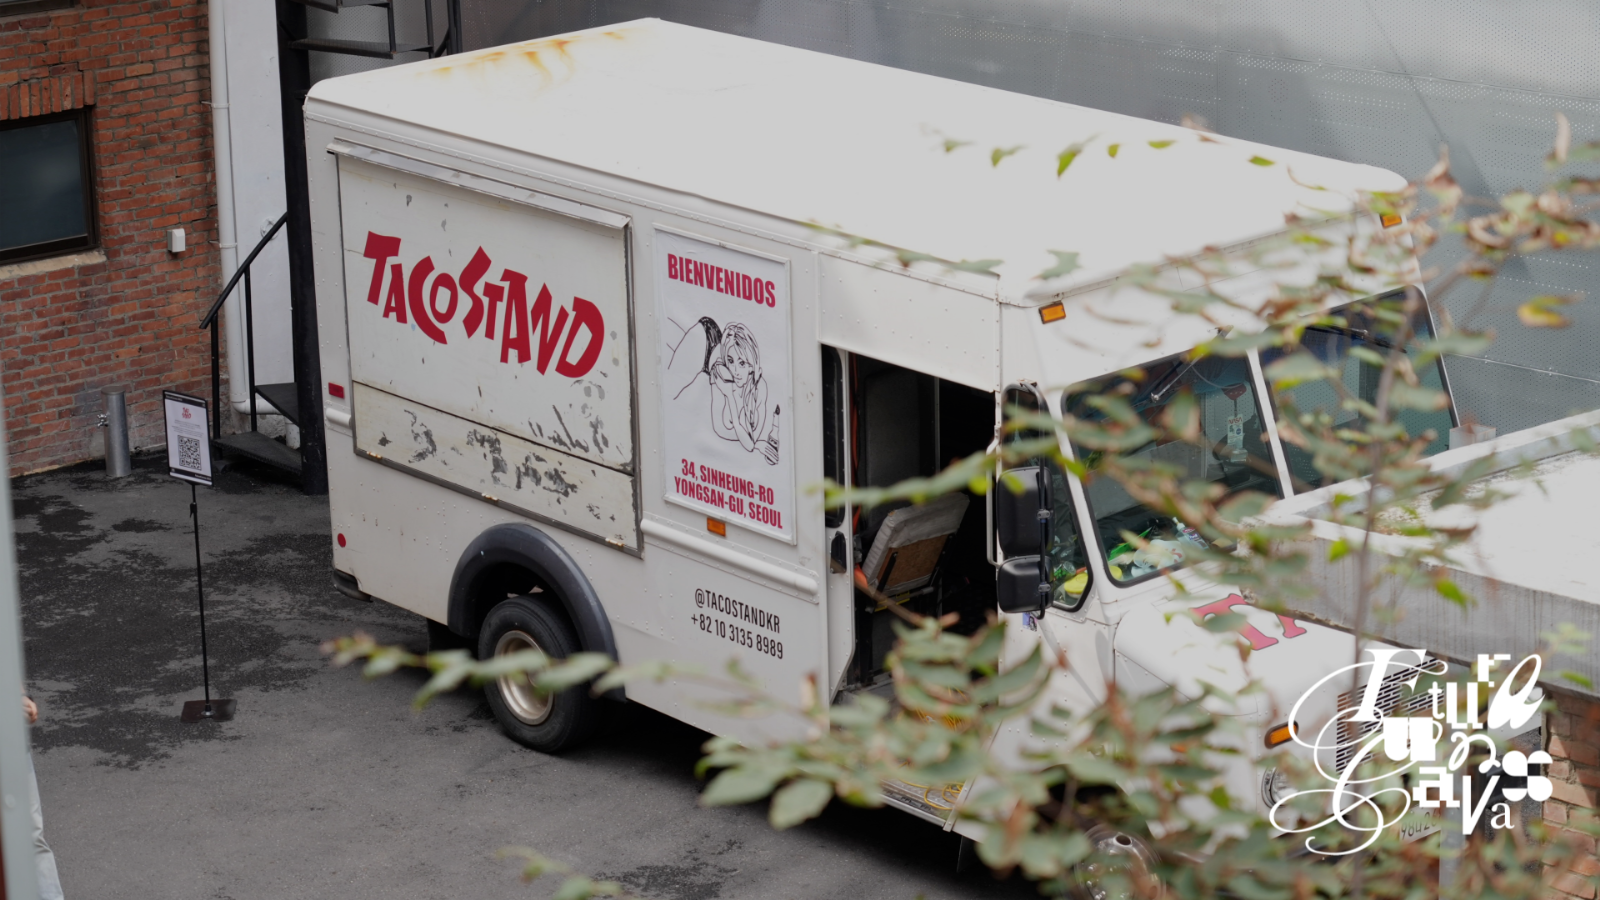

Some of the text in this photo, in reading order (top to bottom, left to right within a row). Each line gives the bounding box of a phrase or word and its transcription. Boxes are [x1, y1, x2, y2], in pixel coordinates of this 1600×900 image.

[667, 253, 777, 308] BIENVENIDOS
[674, 476, 783, 530] YONGSAN-GU, SEOUL
[681, 459, 775, 506] 34, SINHEUNG-RO
[694, 588, 780, 634] @TACOSTANDKR
[691, 613, 784, 660] +82 10 3135 8989
